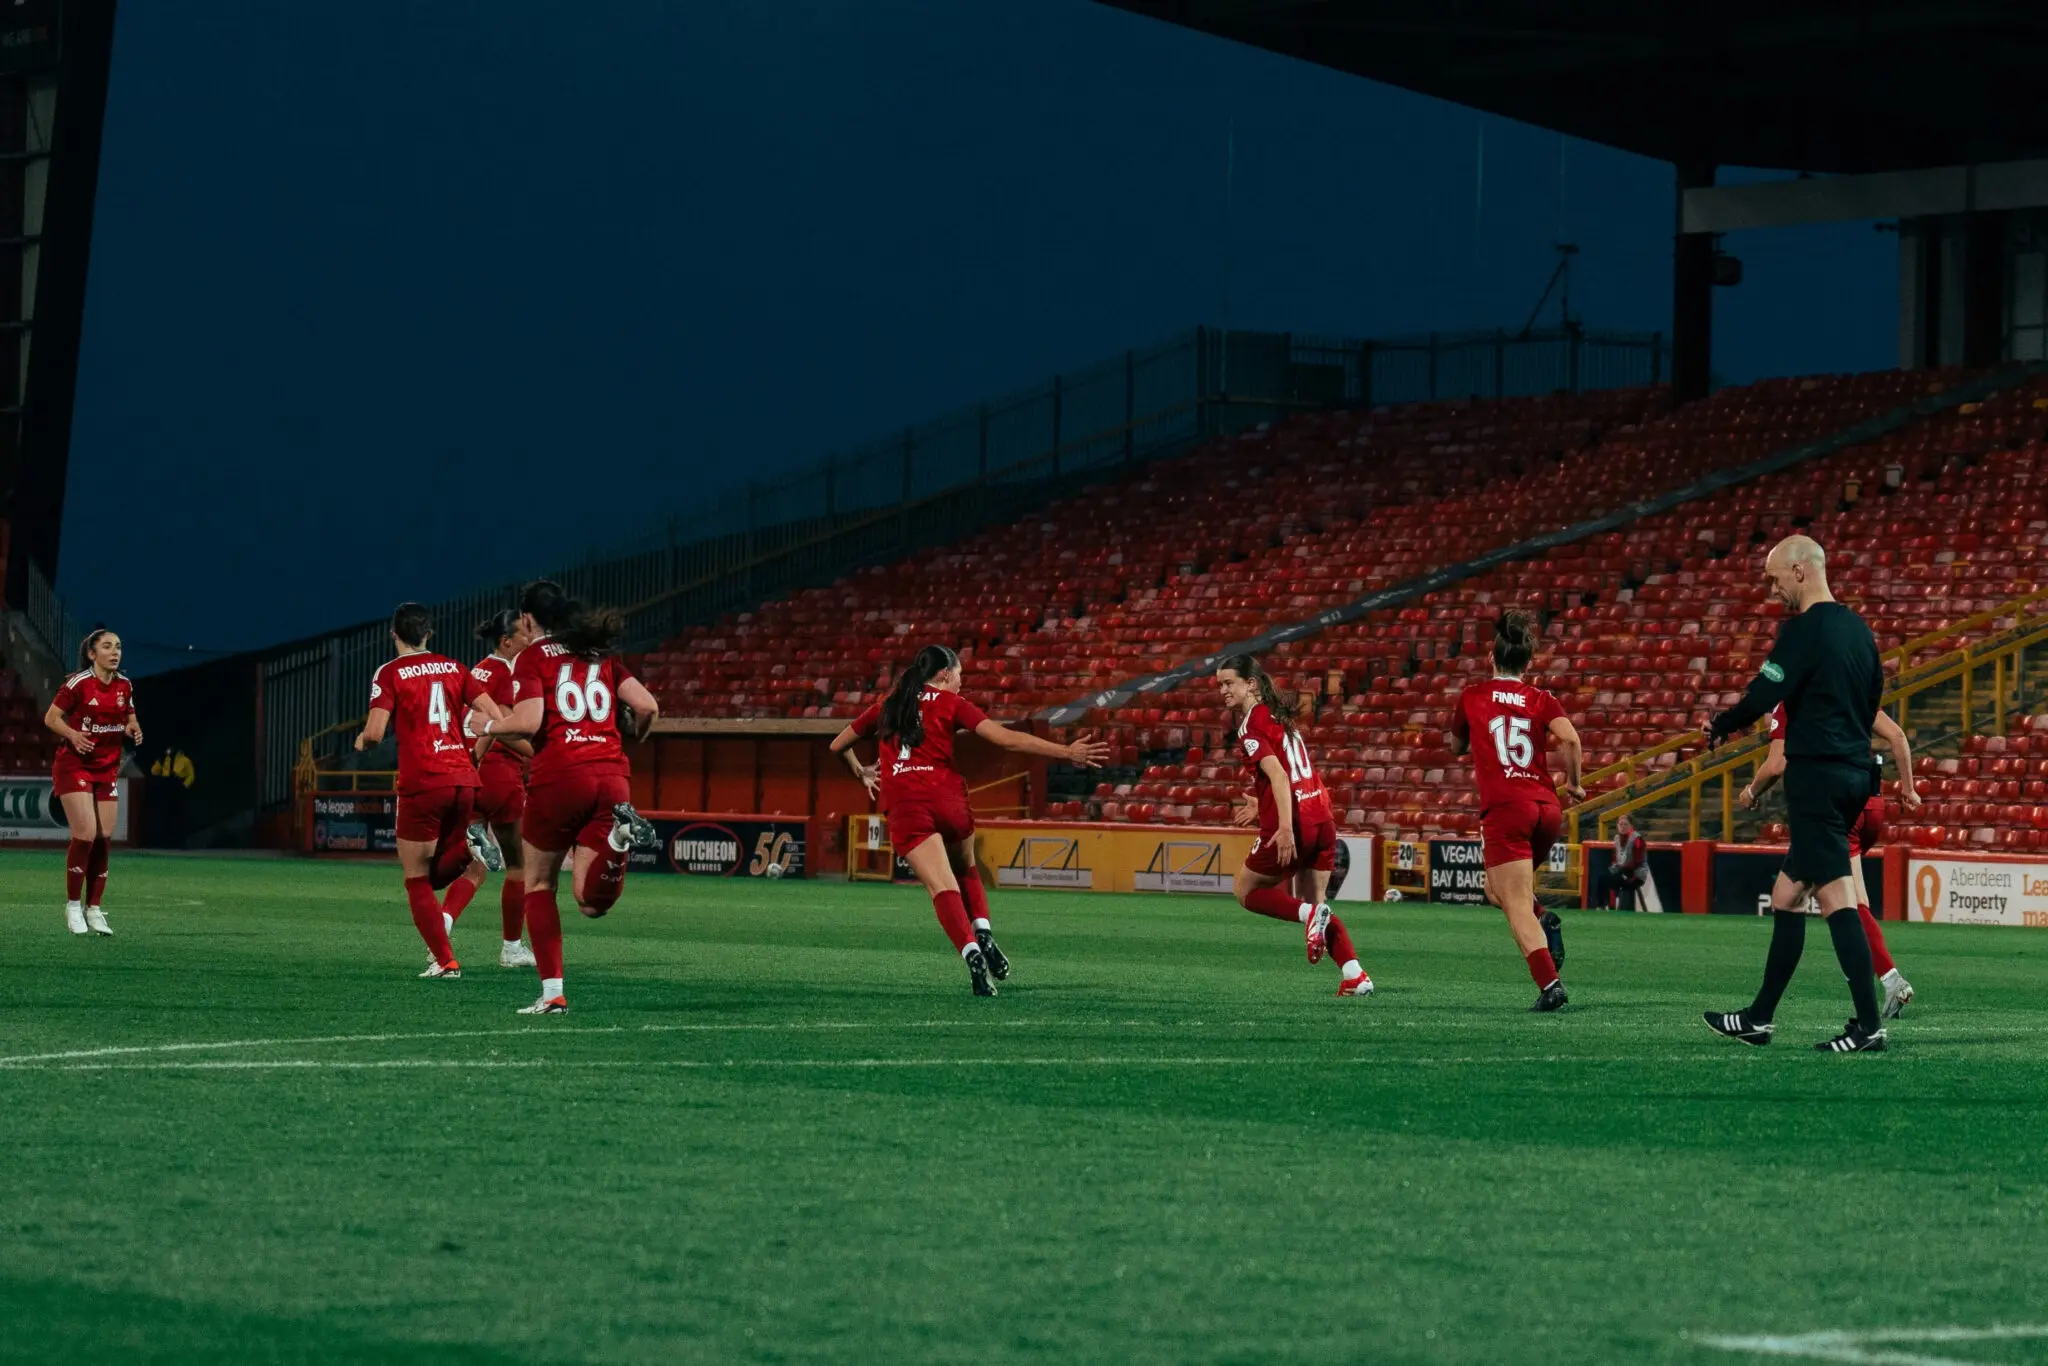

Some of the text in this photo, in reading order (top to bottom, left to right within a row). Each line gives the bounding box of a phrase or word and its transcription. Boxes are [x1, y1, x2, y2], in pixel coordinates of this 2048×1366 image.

[397, 662, 459, 680] BROADRICK
[555, 662, 612, 723] 66
[1492, 690, 1527, 708] FINNIE
[428, 680, 451, 733] 4
[1488, 714, 1534, 769] 15
[1282, 729, 1313, 784] 10
[314, 799, 327, 814] The
[327, 798, 354, 817] league
[869, 825, 880, 841] 19
[674, 840, 737, 861] HUTCHEON
[749, 831, 793, 876] 50
[1401, 844, 1413, 861] 20
[1440, 845, 1483, 864] VEGAN
[1551, 846, 1564, 863] 20
[688, 862, 722, 872] SERVICES
[1432, 869, 1453, 888] BAY
[1949, 867, 2013, 888] Aberdeen
[1948, 890, 2008, 914] Property
